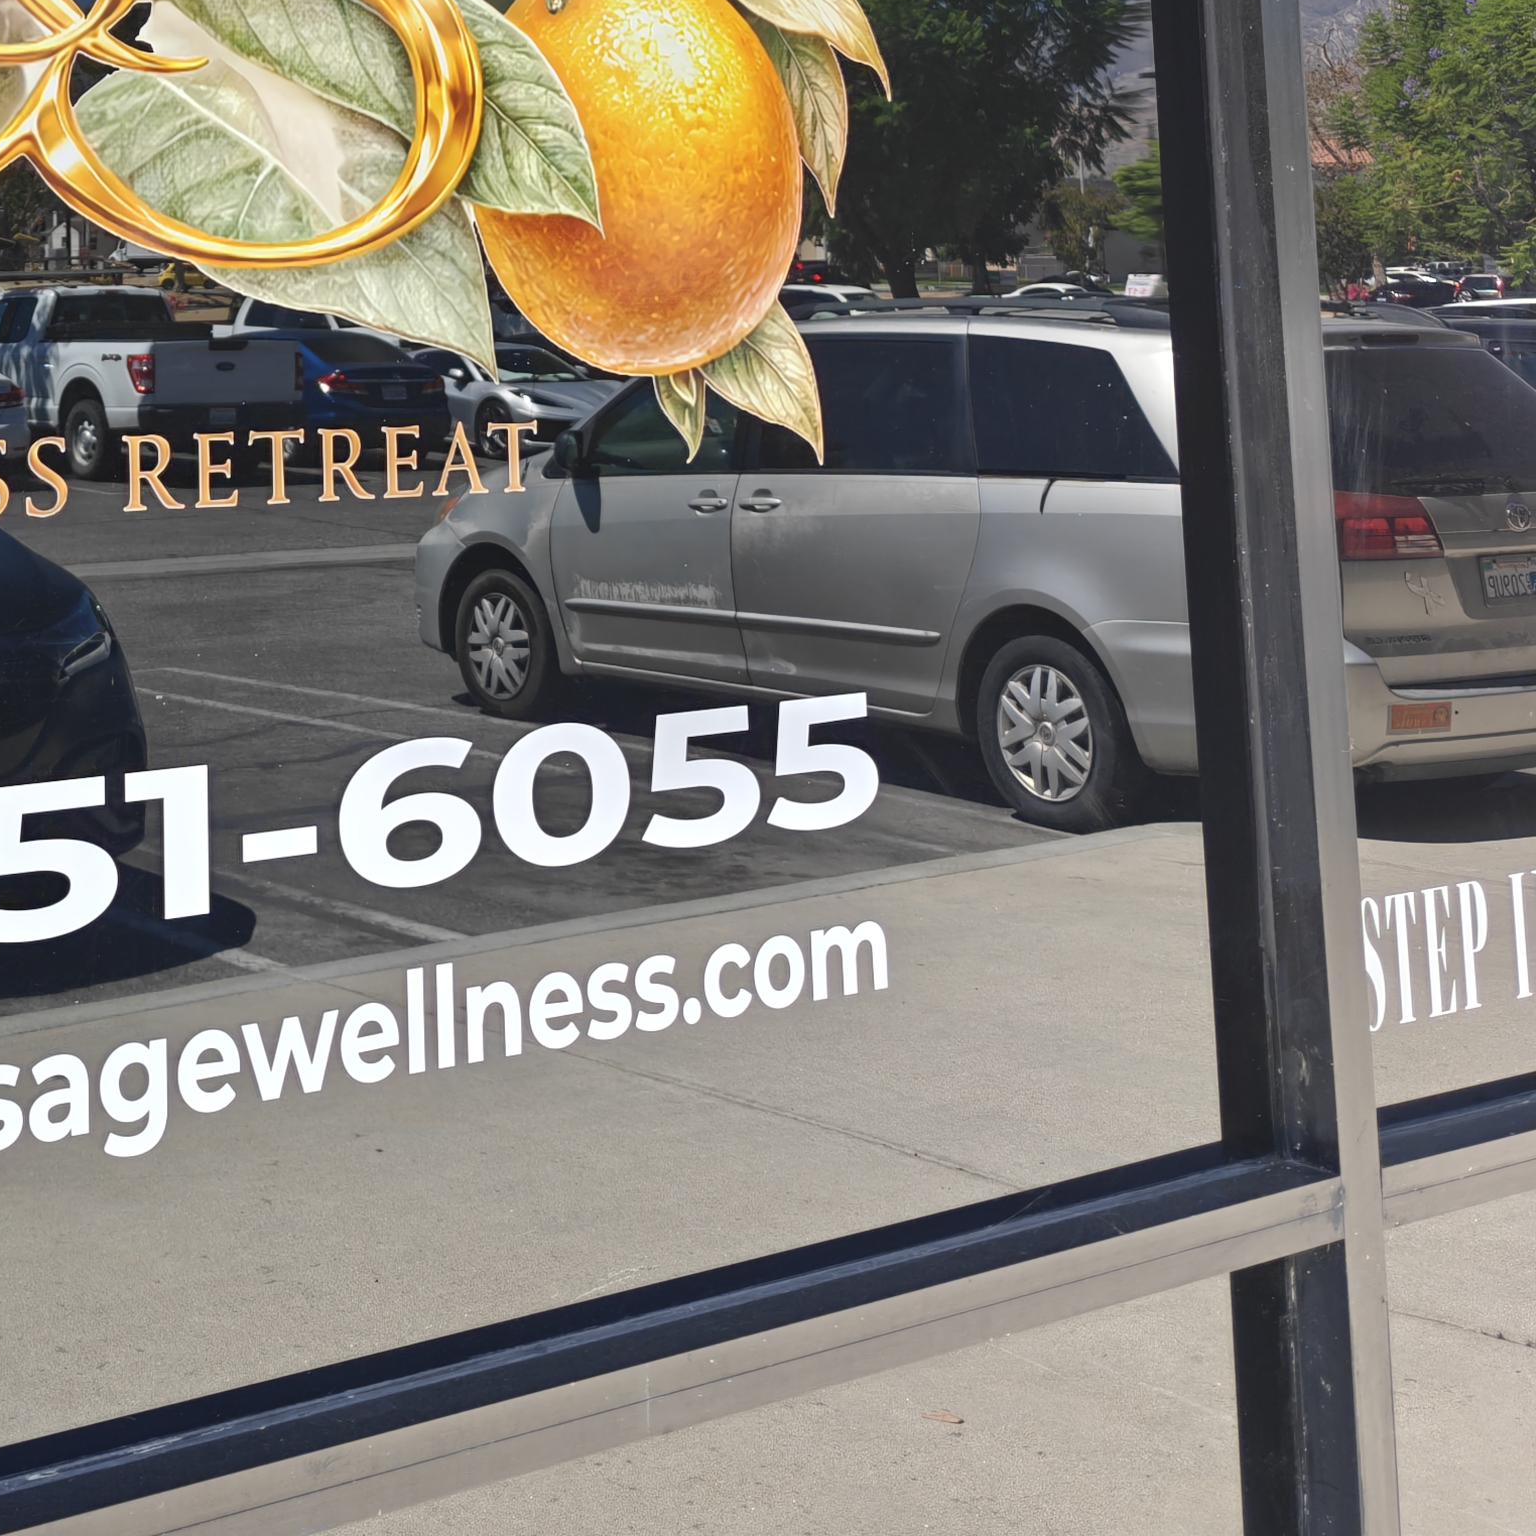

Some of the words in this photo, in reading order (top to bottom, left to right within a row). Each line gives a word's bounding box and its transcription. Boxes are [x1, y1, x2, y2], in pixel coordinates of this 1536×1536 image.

[121, 419, 538, 513] RETREAT
[1361, 880, 1488, 1032] STEP
[1508, 869, 1536, 1000] I
